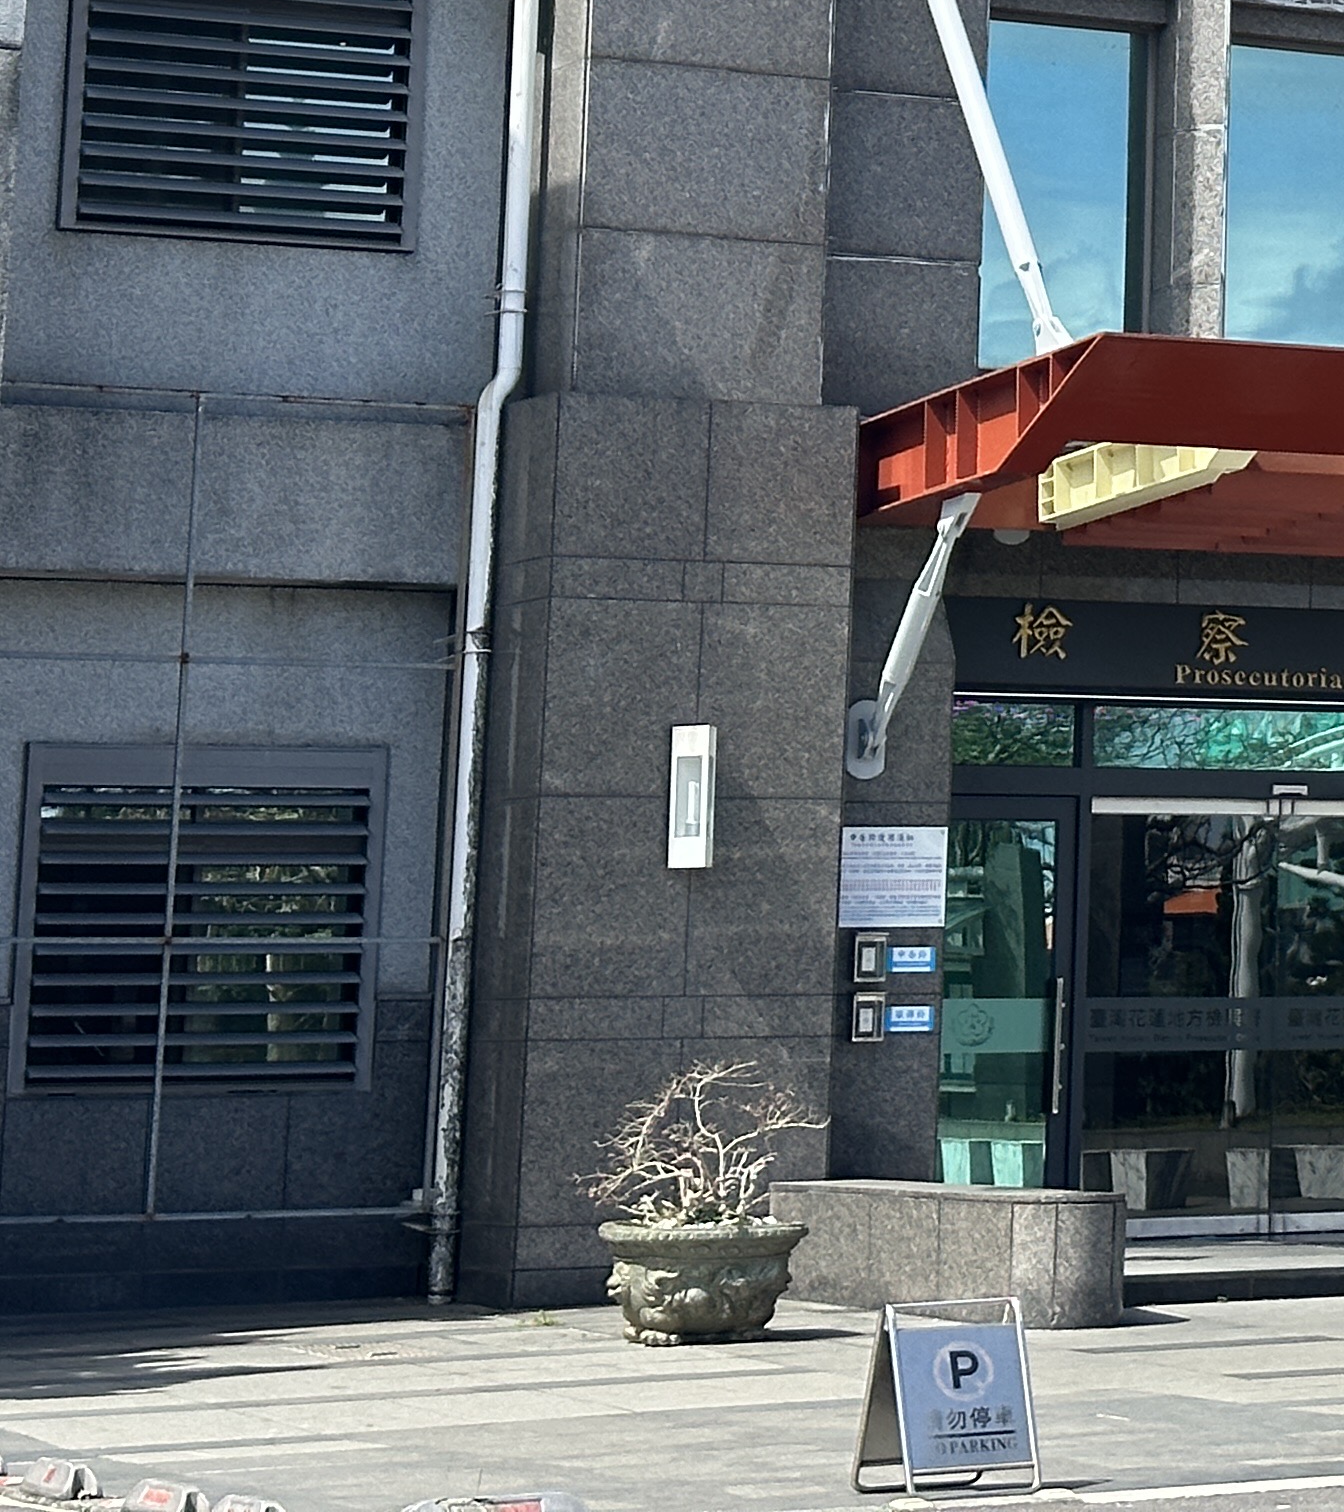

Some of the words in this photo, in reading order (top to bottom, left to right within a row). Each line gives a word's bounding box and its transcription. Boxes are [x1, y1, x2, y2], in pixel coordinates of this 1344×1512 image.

[949, 1350, 979, 1390] P
[929, 1405, 1014, 1430] 勿停車
